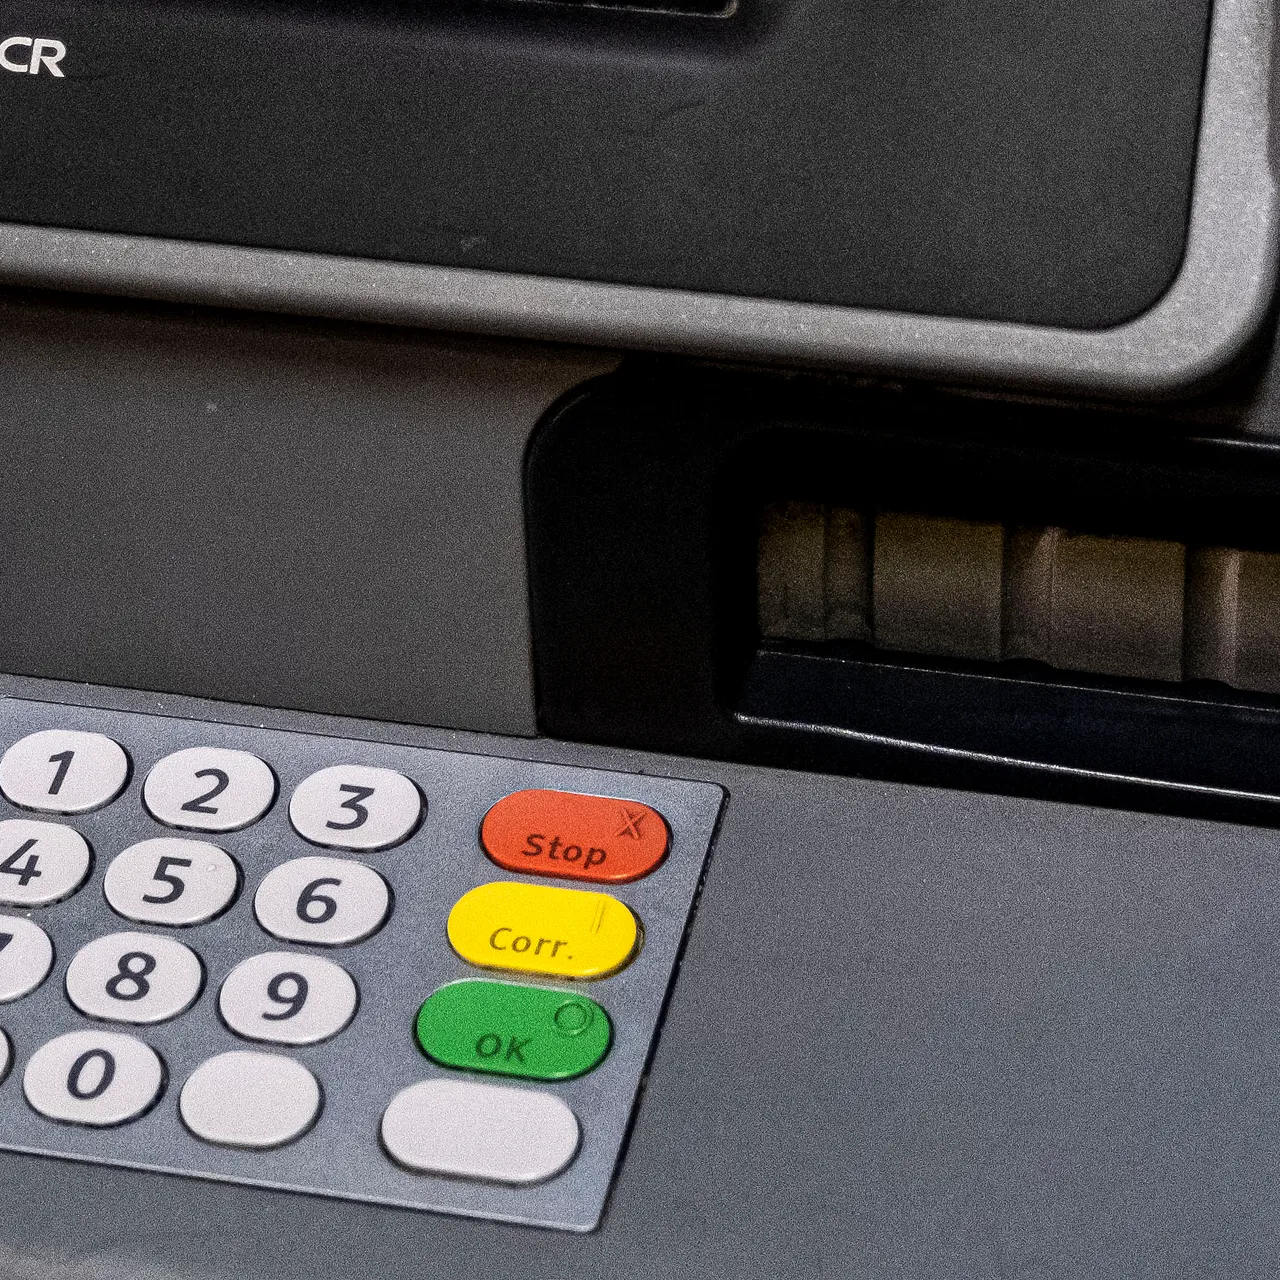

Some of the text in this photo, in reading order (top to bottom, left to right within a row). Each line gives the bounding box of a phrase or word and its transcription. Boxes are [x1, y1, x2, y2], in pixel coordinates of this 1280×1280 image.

[46, 749, 376, 832] 1 2 3
[522, 832, 609, 869] Stop
[142, 857, 193, 905] 5
[295, 877, 340, 922] 6
[489, 926, 576, 962] Corr.
[106, 952, 157, 1001] 8
[265, 971, 310, 1021] 9
[477, 1033, 531, 1063] OK
[67, 1049, 115, 1099] 0
